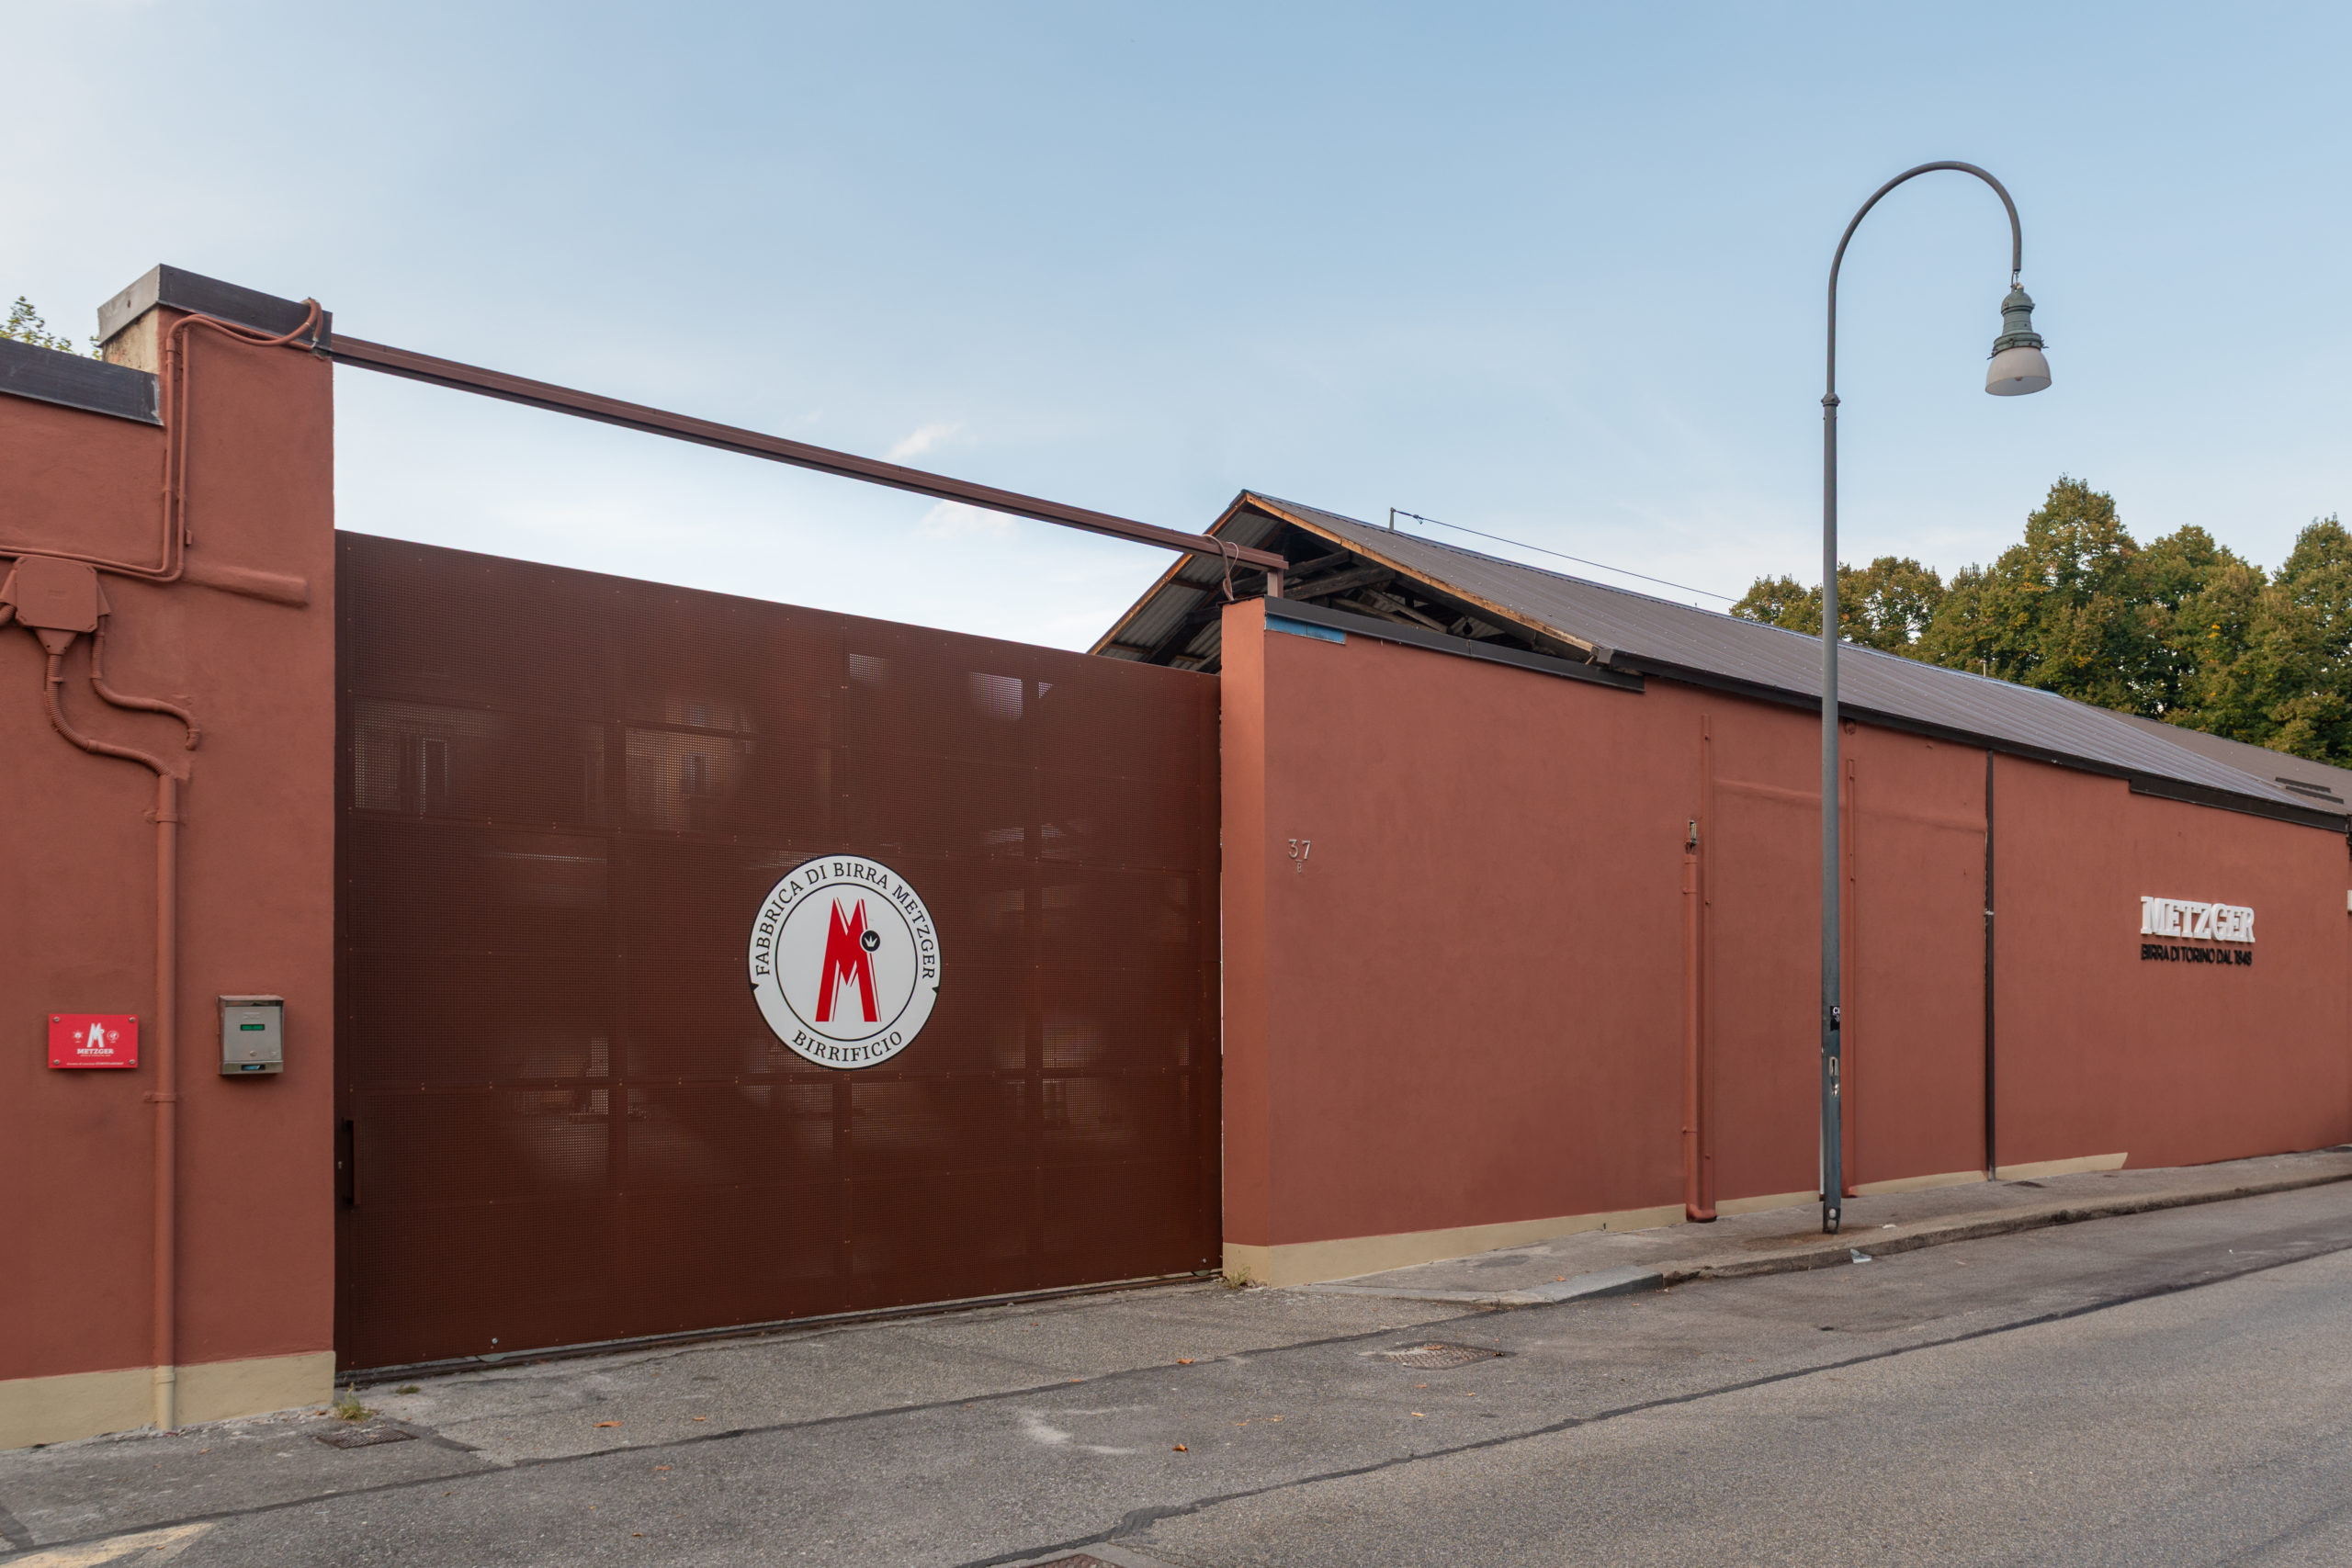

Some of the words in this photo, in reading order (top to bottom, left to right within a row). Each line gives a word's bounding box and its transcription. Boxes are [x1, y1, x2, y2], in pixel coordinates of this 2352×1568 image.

[1288, 839, 1311, 860] 37
[755, 880, 804, 976] FABBRICA
[805, 864, 828, 886] DI
[833, 862, 888, 890] BIRRA
[892, 884, 936, 980] METZGER
[2140, 896, 2256, 943] METZGER
[2141, 943, 2169, 962] BIRRA
[2170, 946, 2180, 963] DI
[2181, 946, 2215, 964] TORINO
[2217, 948, 2233, 965] DAL
[792, 1030, 903, 1063] BIRRIFICIO
